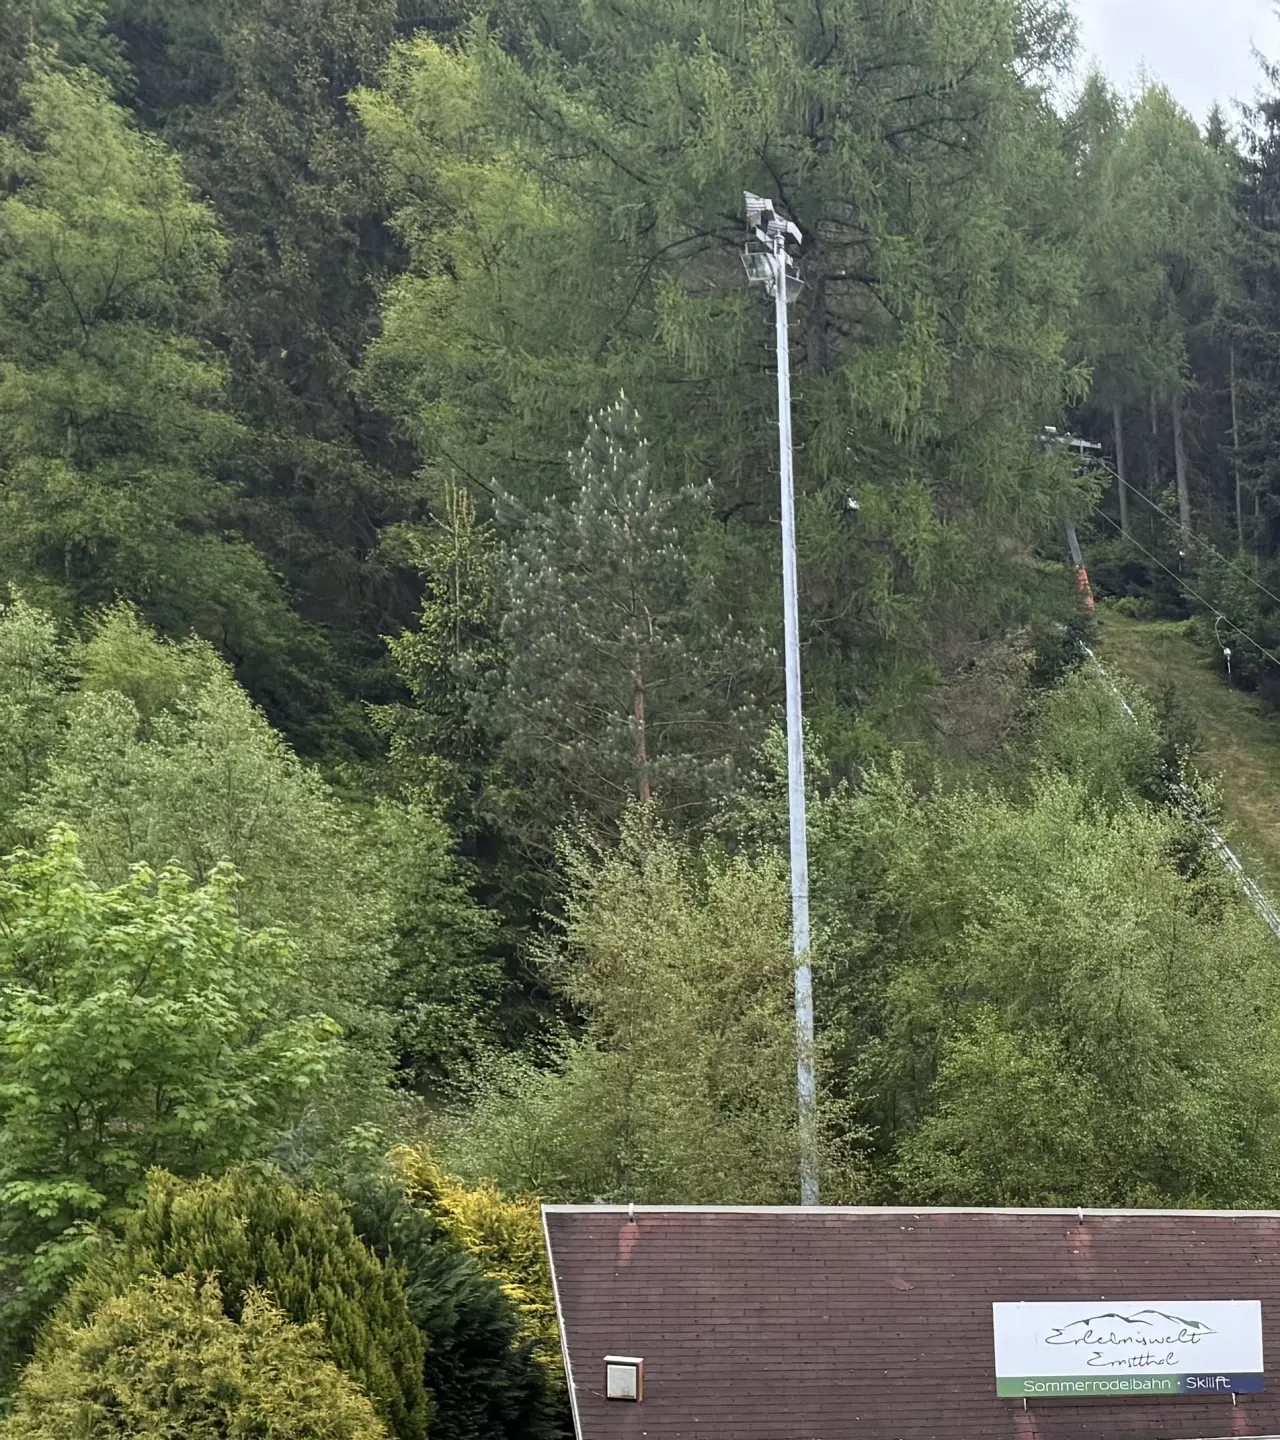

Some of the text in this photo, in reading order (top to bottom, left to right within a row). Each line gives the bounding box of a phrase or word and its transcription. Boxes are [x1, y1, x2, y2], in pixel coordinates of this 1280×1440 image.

[1045, 1328, 1215, 1345] Erlebniswelt
[1087, 1351, 1179, 1368] Ernstthal
[1024, 1375, 1231, 1393] Sommerrodelbahn Skilift
